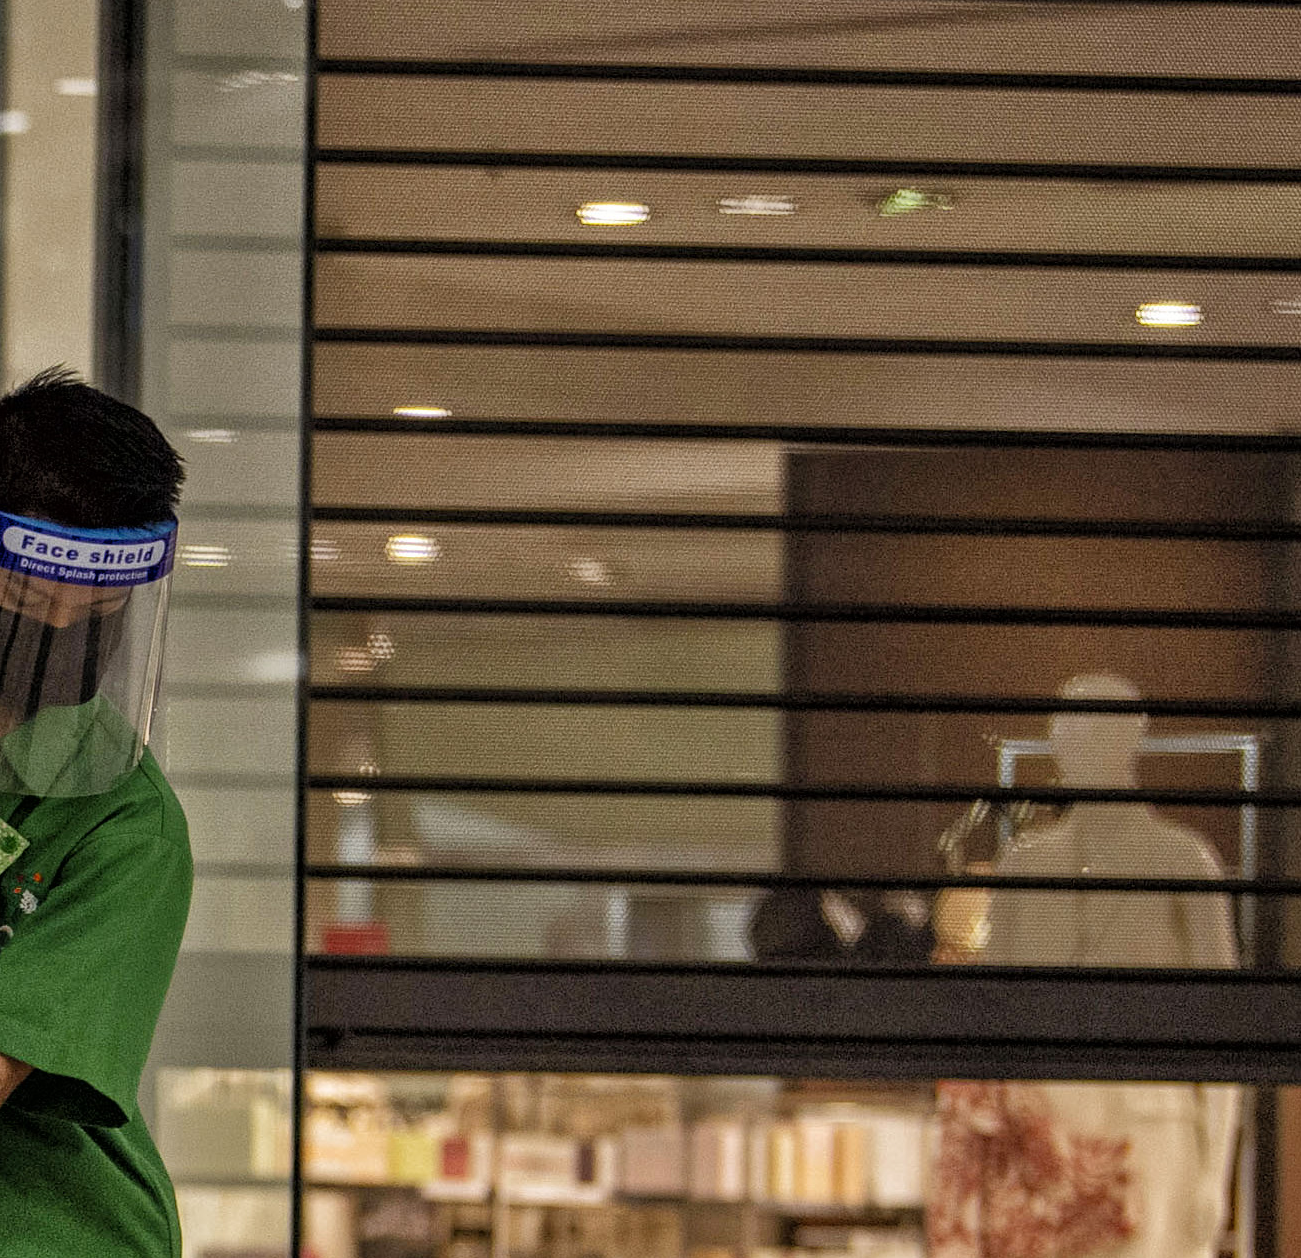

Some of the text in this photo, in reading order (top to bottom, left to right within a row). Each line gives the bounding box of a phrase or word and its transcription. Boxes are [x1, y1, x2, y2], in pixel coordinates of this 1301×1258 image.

[21, 534, 155, 563] Face shield
[20, 558, 148, 582] Direct Splash protection
